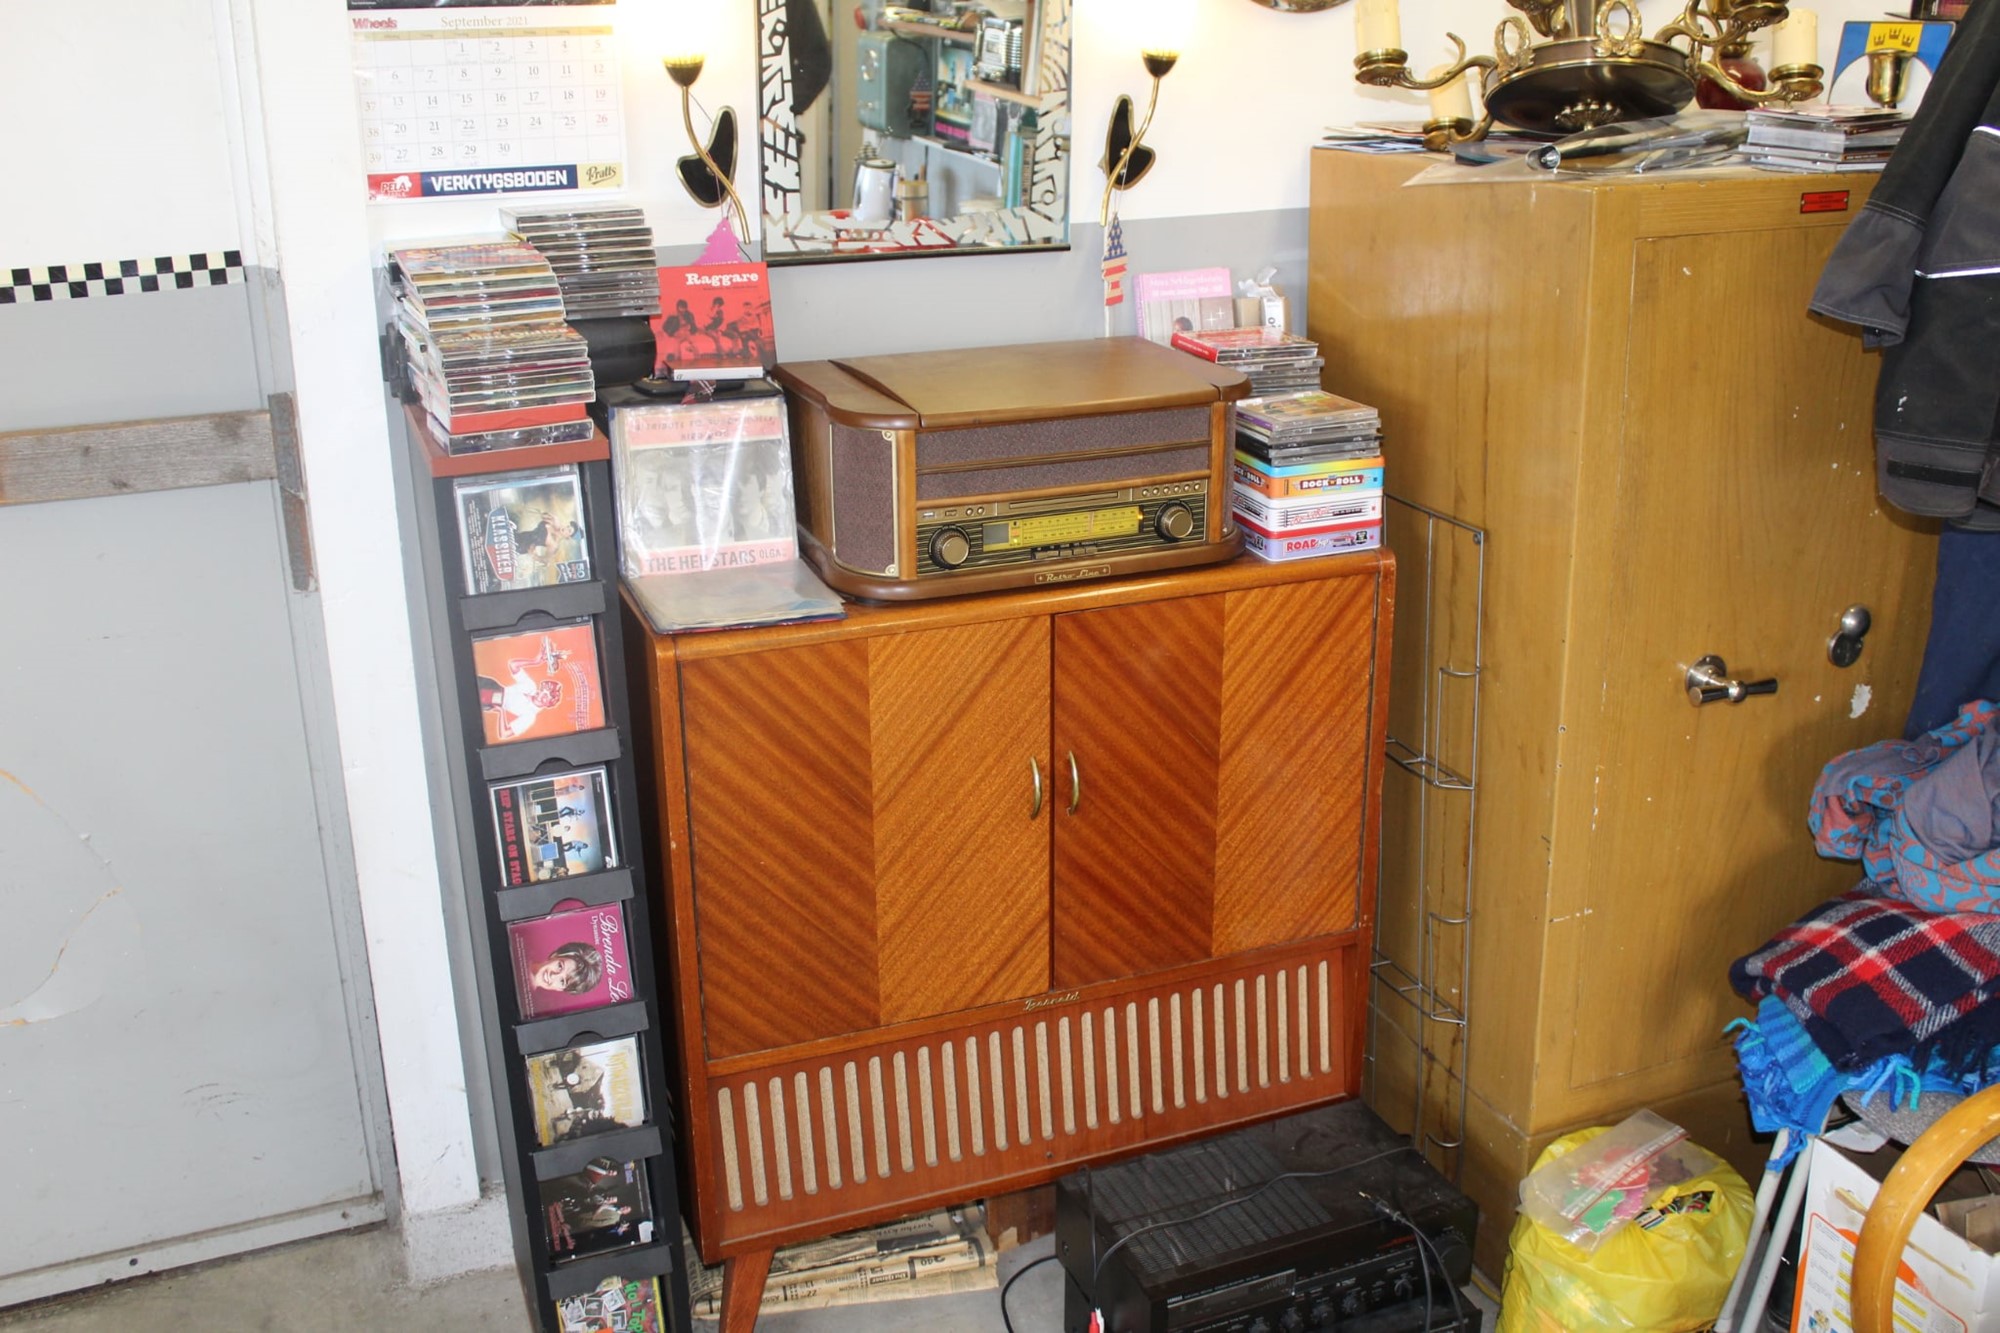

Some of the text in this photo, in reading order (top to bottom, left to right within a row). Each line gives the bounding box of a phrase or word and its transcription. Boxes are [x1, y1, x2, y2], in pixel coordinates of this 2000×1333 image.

[352, 17, 398, 30] Wheels
[441, 16, 529, 29] September 2021
[528, 66, 539, 76] 10
[427, 96, 438, 106] 14
[462, 94, 473, 104] 15
[495, 92, 506, 102] 16
[529, 91, 539, 101] 17
[563, 90, 574, 100] 18
[394, 124, 407, 134] 20
[429, 122, 440, 132] 21
[463, 120, 475, 130] 22
[496, 118, 509, 128] 23
[530, 117, 541, 126] 24
[564, 116, 576, 126] 25
[596, 114, 608, 124] 26
[396, 150, 408, 160] 27
[431, 146, 443, 156] 28
[464, 145, 476, 155] 29
[430, 170, 568, 192] VERKTYGSBODEN
[586, 166, 617, 185] Pratts
[381, 182, 407, 193] PELA
[685, 272, 759, 288] Raggare
[1301, 478, 1331, 490] ROCK
[1336, 475, 1362, 487] ROLL
[490, 514, 513, 575] KLASSIKER
[1286, 538, 1318, 552] ROAD
[646, 556, 676, 573] THE
[712, 549, 757, 567] STARS
[1044, 571, 1075, 583] Retro
[599, 911, 622, 977] Brenda
